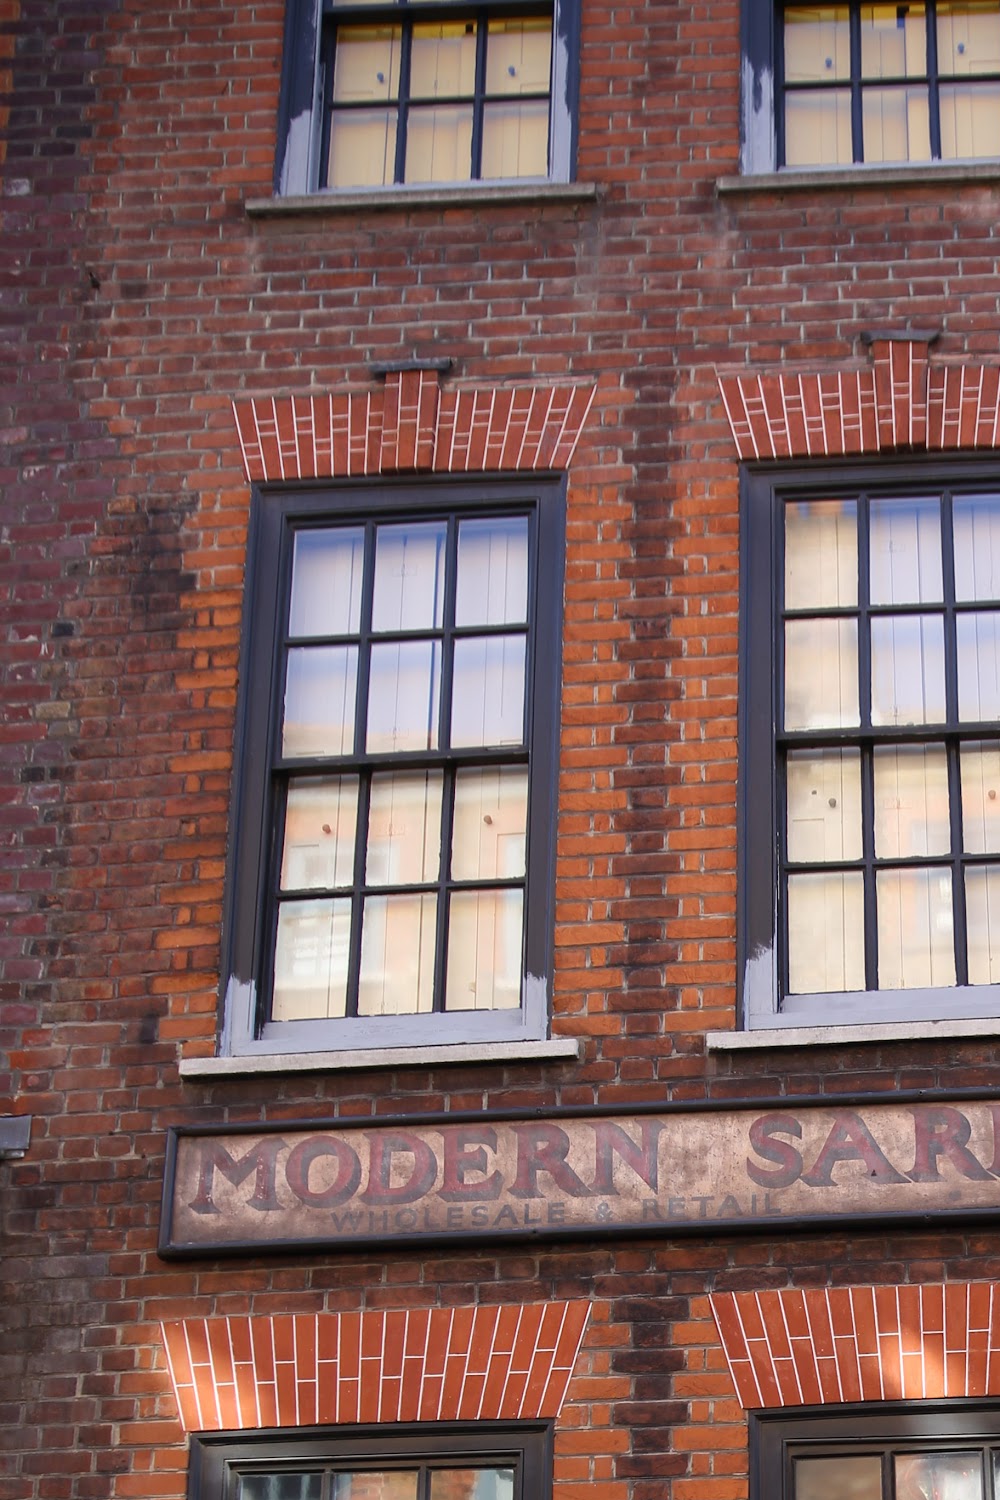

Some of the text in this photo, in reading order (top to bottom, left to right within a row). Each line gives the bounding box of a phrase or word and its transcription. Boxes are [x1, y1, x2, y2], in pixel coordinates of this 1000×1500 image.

[188, 1119, 667, 1215] MODERN
[330, 1193, 781, 1233] WHOLESALE & RETAIL
